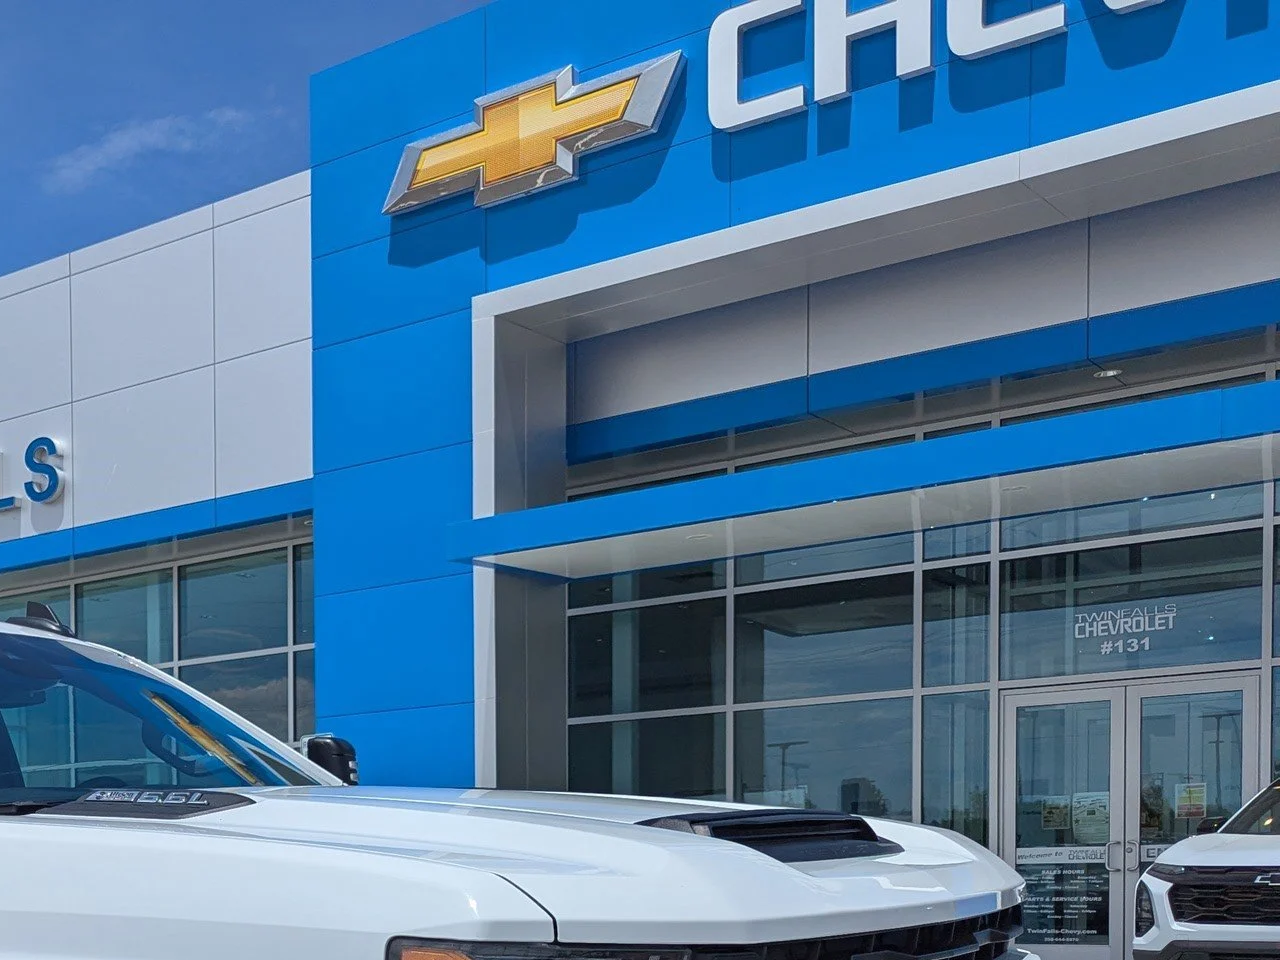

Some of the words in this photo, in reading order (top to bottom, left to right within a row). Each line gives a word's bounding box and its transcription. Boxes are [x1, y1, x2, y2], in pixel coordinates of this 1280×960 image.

[1075, 613, 1176, 638] CHEVROLET
[1101, 637, 1150, 655] #131
[137, 792, 206, 804] 6.6L
